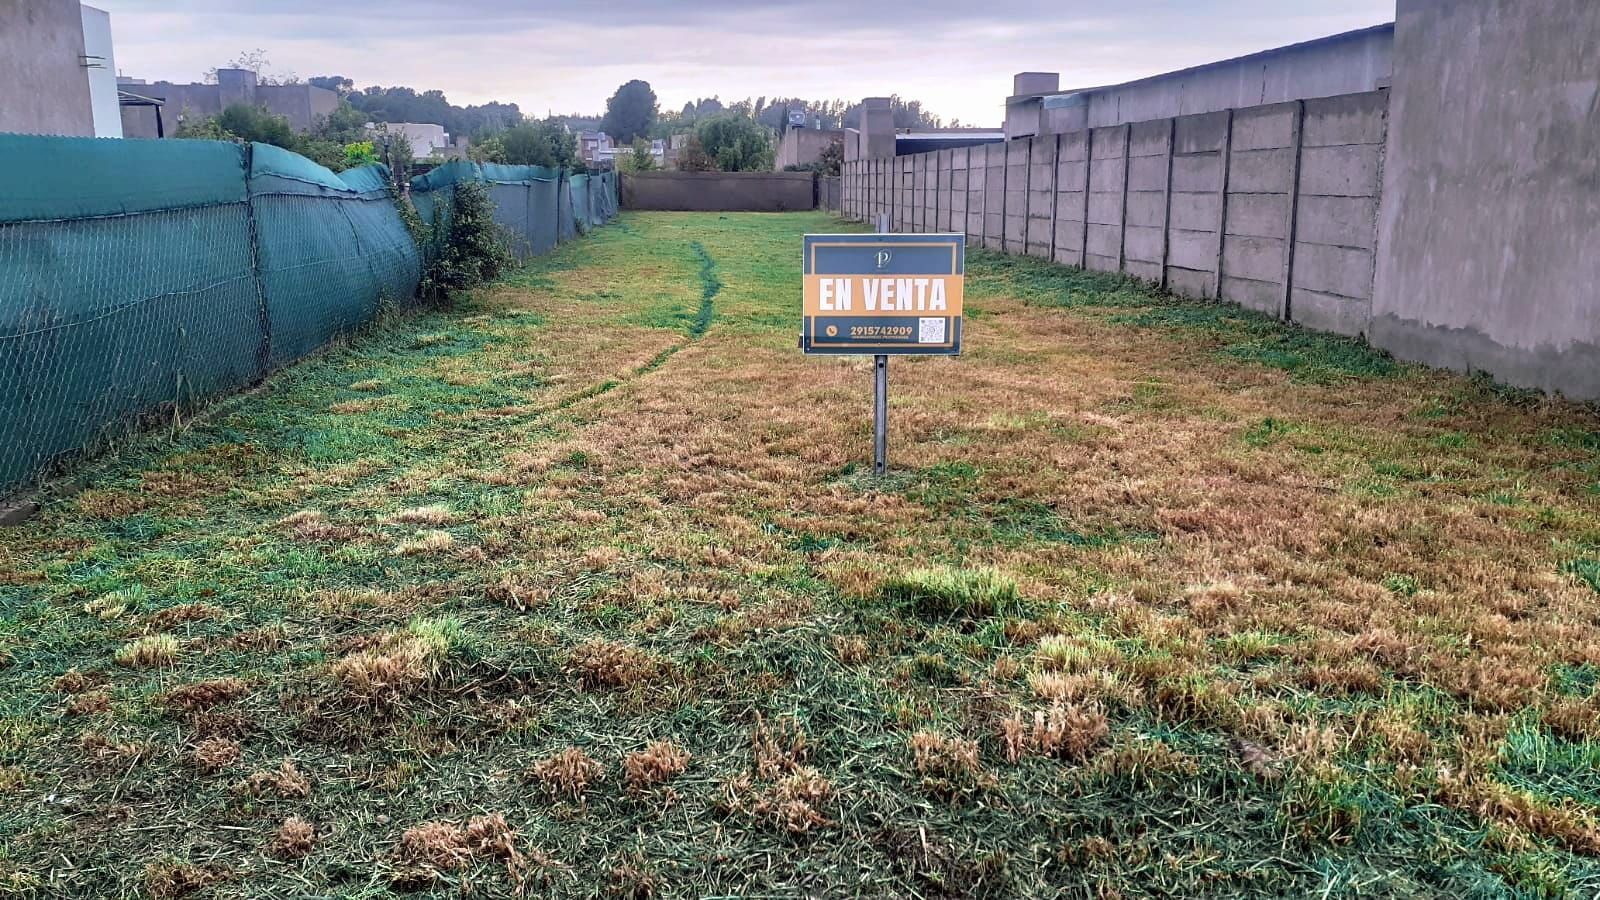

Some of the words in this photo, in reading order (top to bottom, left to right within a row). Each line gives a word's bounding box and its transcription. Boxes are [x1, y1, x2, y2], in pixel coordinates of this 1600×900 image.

[819, 278, 852, 311] EN
[862, 278, 947, 311] VENTA
[850, 326, 913, 336] 2915742909
